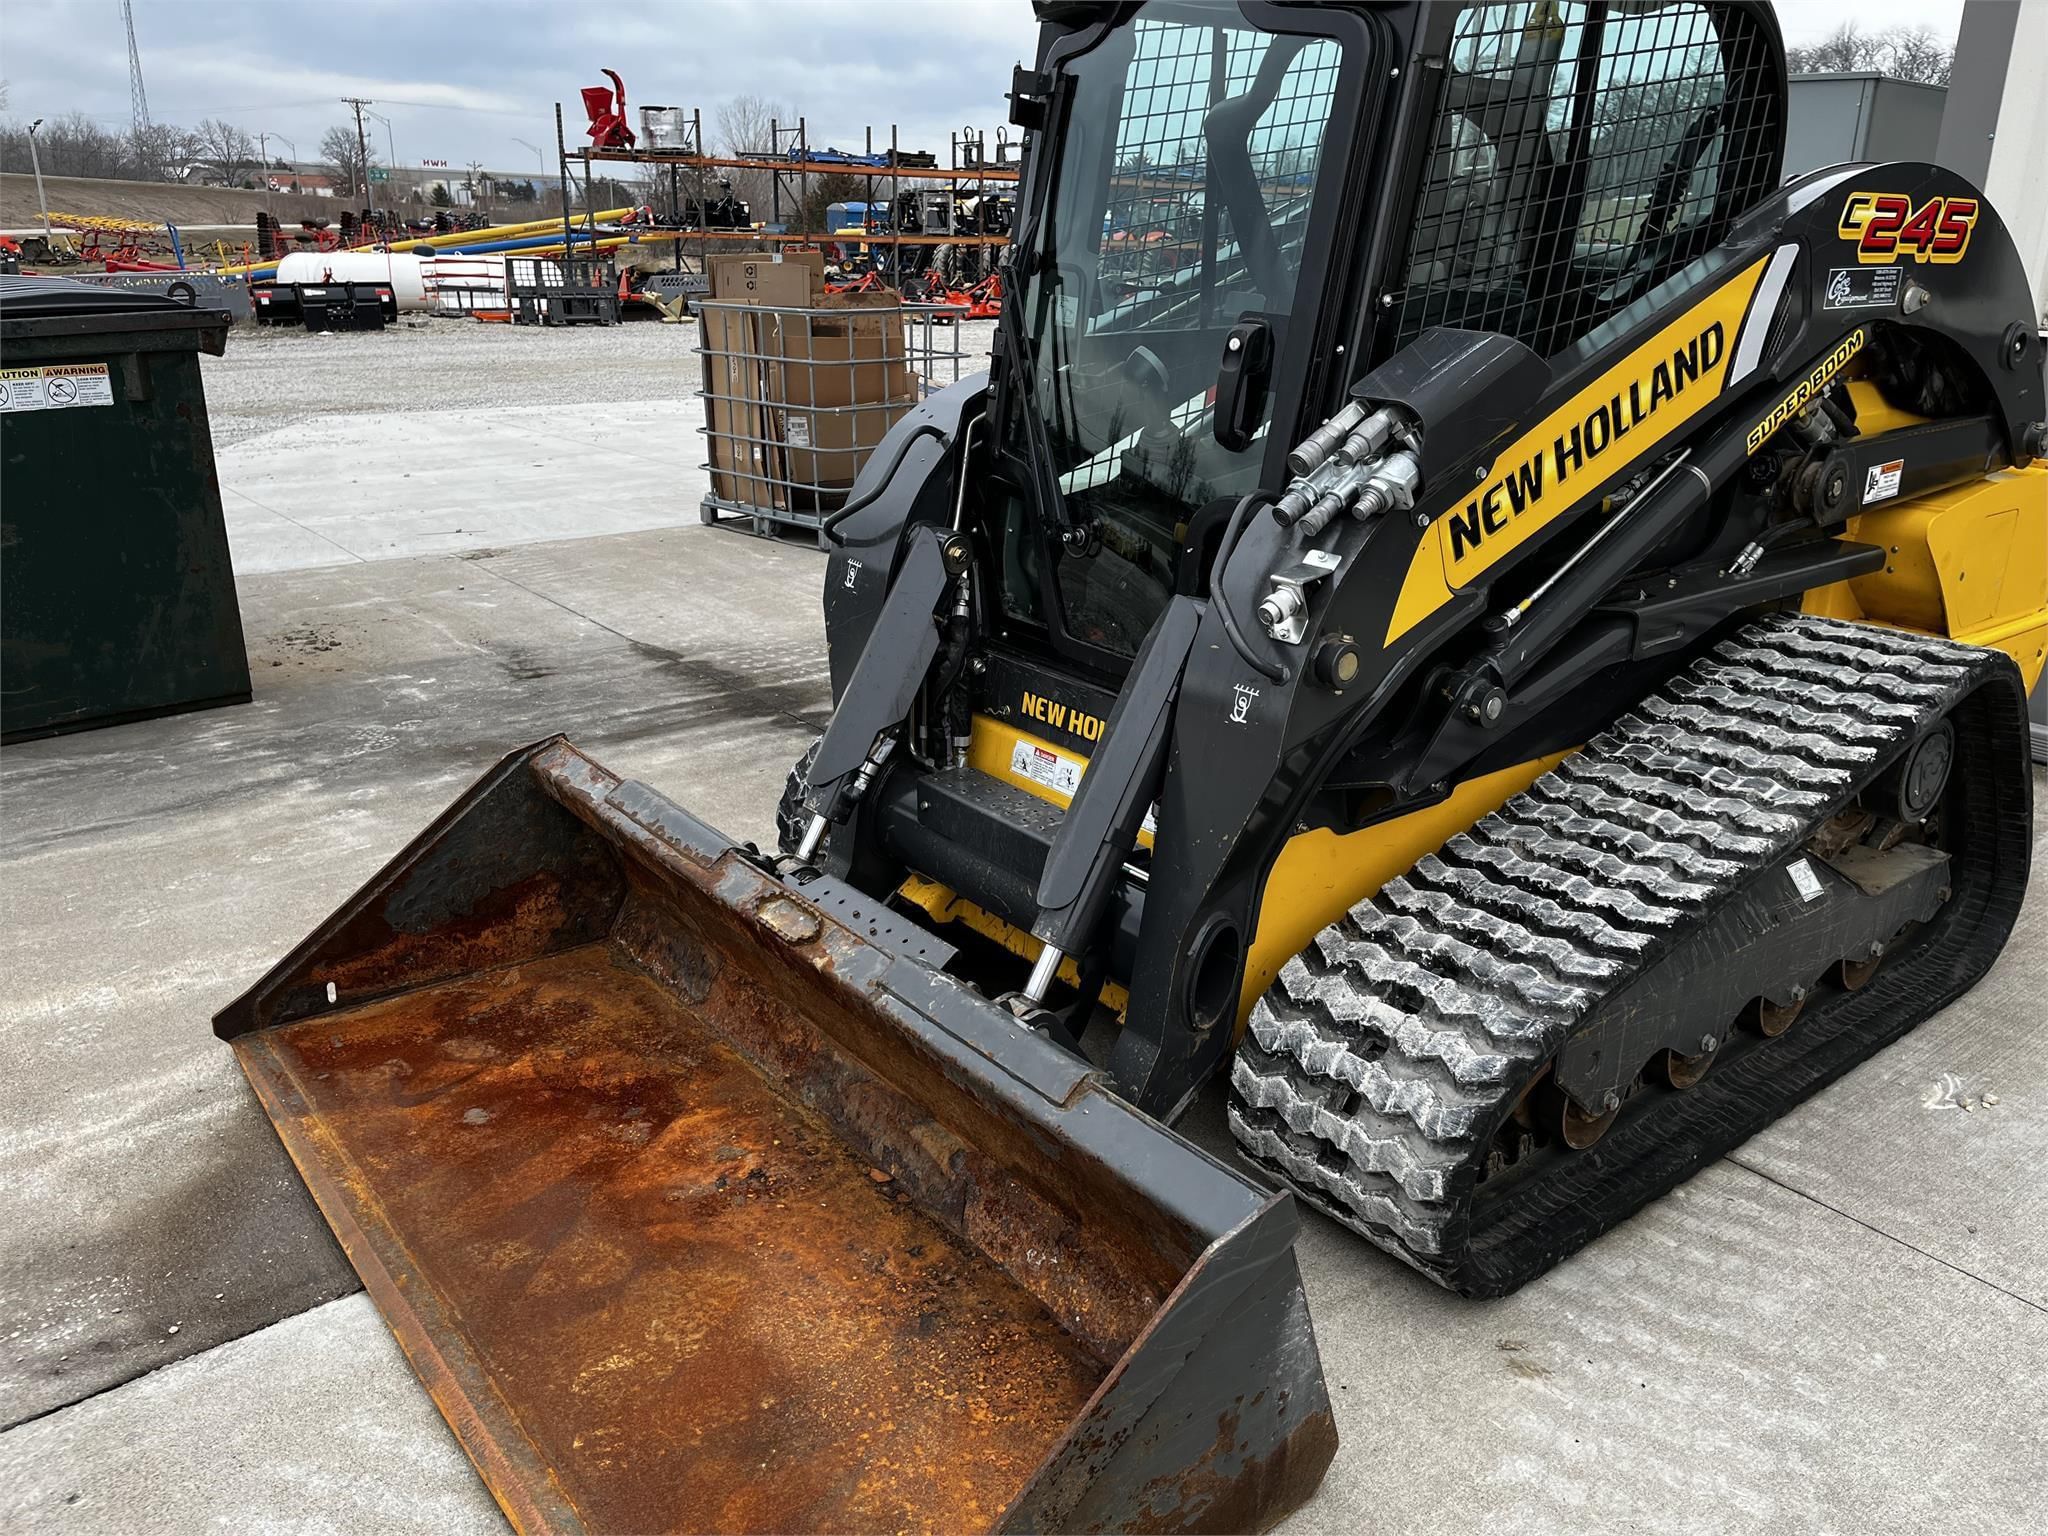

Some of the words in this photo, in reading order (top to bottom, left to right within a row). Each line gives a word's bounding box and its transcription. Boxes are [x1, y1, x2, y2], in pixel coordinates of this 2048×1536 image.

[423, 159, 447, 168] HWH
[1839, 192, 1979, 264] C245
[1835, 287, 1868, 306] Equipment
[51, 366, 106, 376] WARNING
[1746, 381, 1811, 456] SUPER
[1810, 329, 1864, 394] BOOM
[1448, 449, 1544, 563] NEW
[1553, 319, 1725, 485] HOLLAND
[1021, 691, 1066, 728] NEW
